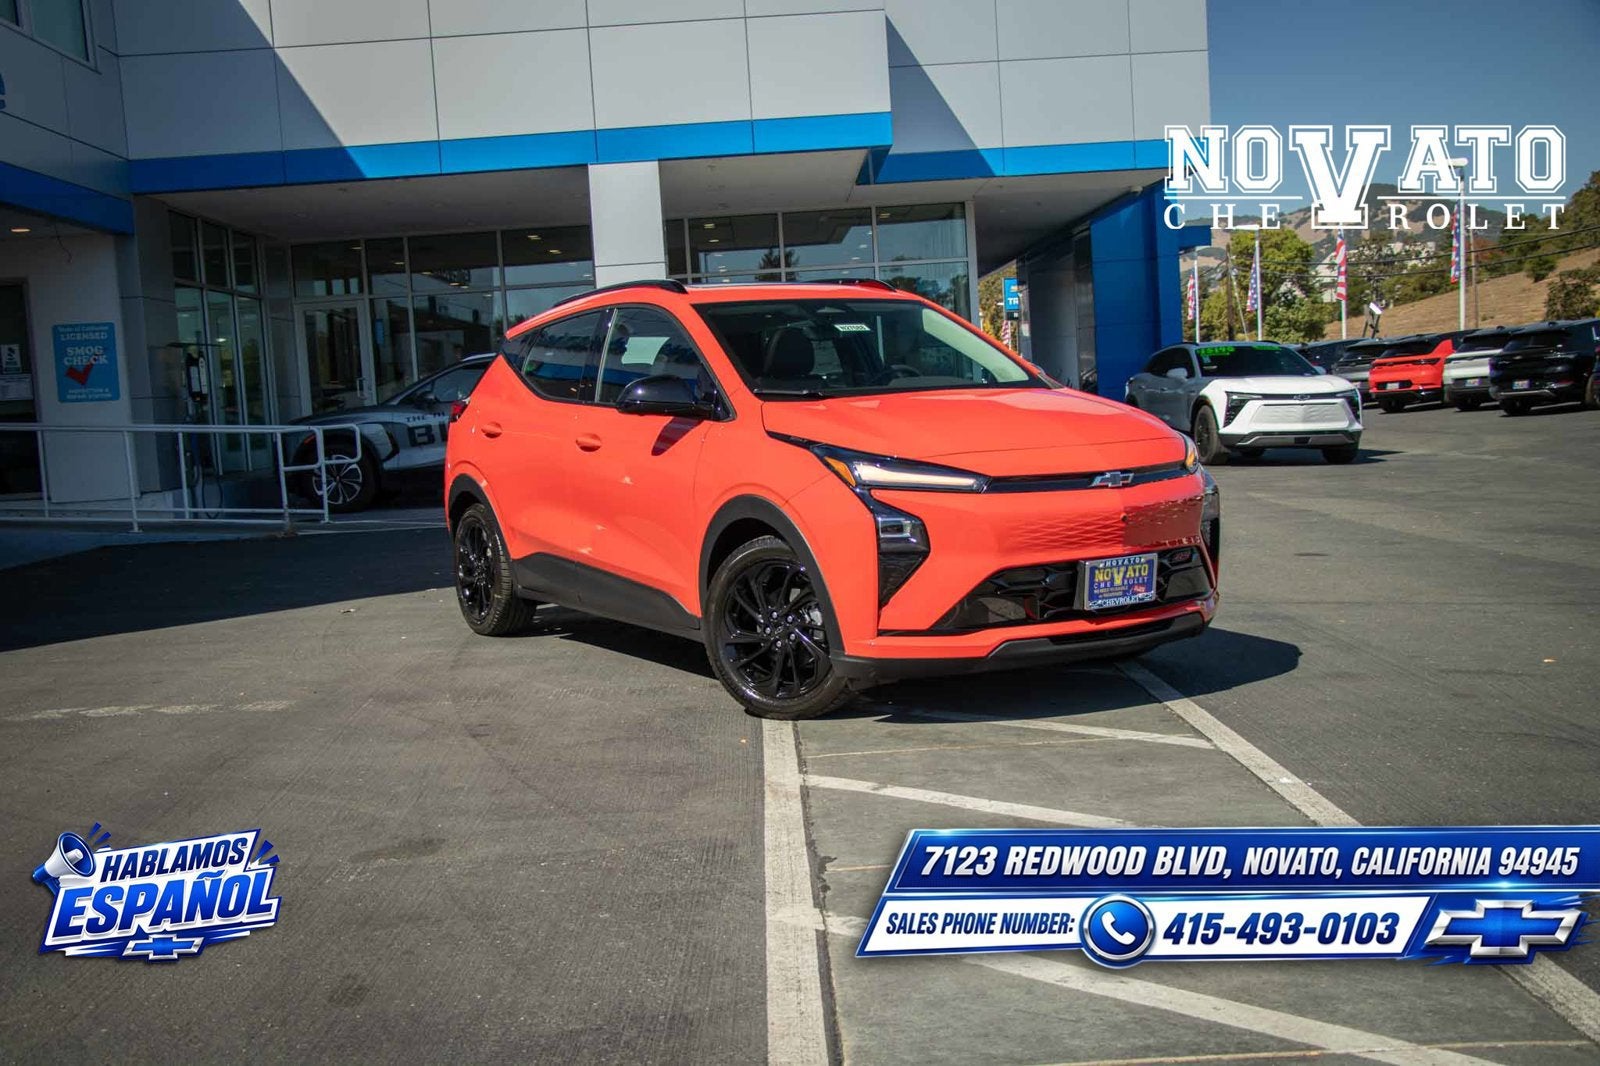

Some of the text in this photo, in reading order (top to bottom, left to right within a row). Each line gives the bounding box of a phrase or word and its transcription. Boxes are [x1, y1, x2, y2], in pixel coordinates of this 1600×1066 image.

[66, 345, 104, 356] SMOG
[63, 355, 108, 366] CHECK
[1105, 557, 1141, 567] NOVATO
[1094, 564, 1149, 587] NOVATO
[1101, 595, 1140, 606] CHEVROLET
